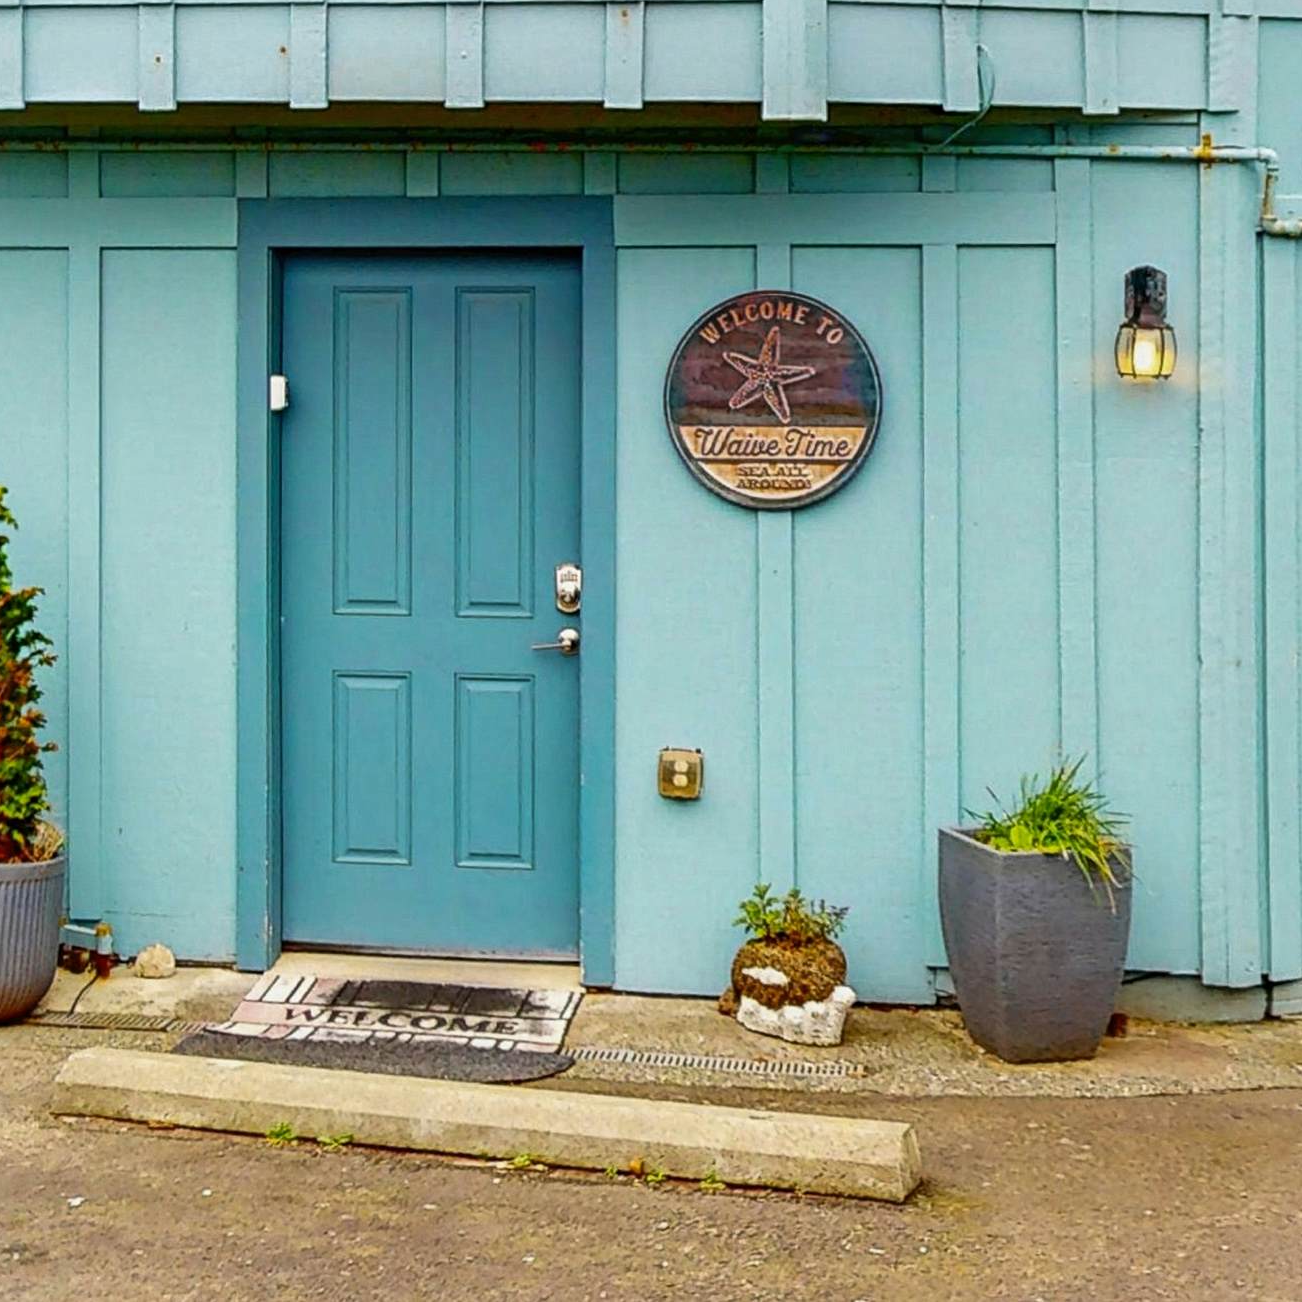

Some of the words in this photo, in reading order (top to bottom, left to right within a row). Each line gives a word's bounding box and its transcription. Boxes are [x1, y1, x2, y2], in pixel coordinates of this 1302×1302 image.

[699, 301, 810, 344] WELCOME
[816, 316, 844, 344] TO
[785, 427, 852, 457] Time
[737, 466, 771, 478] SEA
[776, 466, 810, 478] ALL
[285, 1007, 519, 1036] WELCOME
